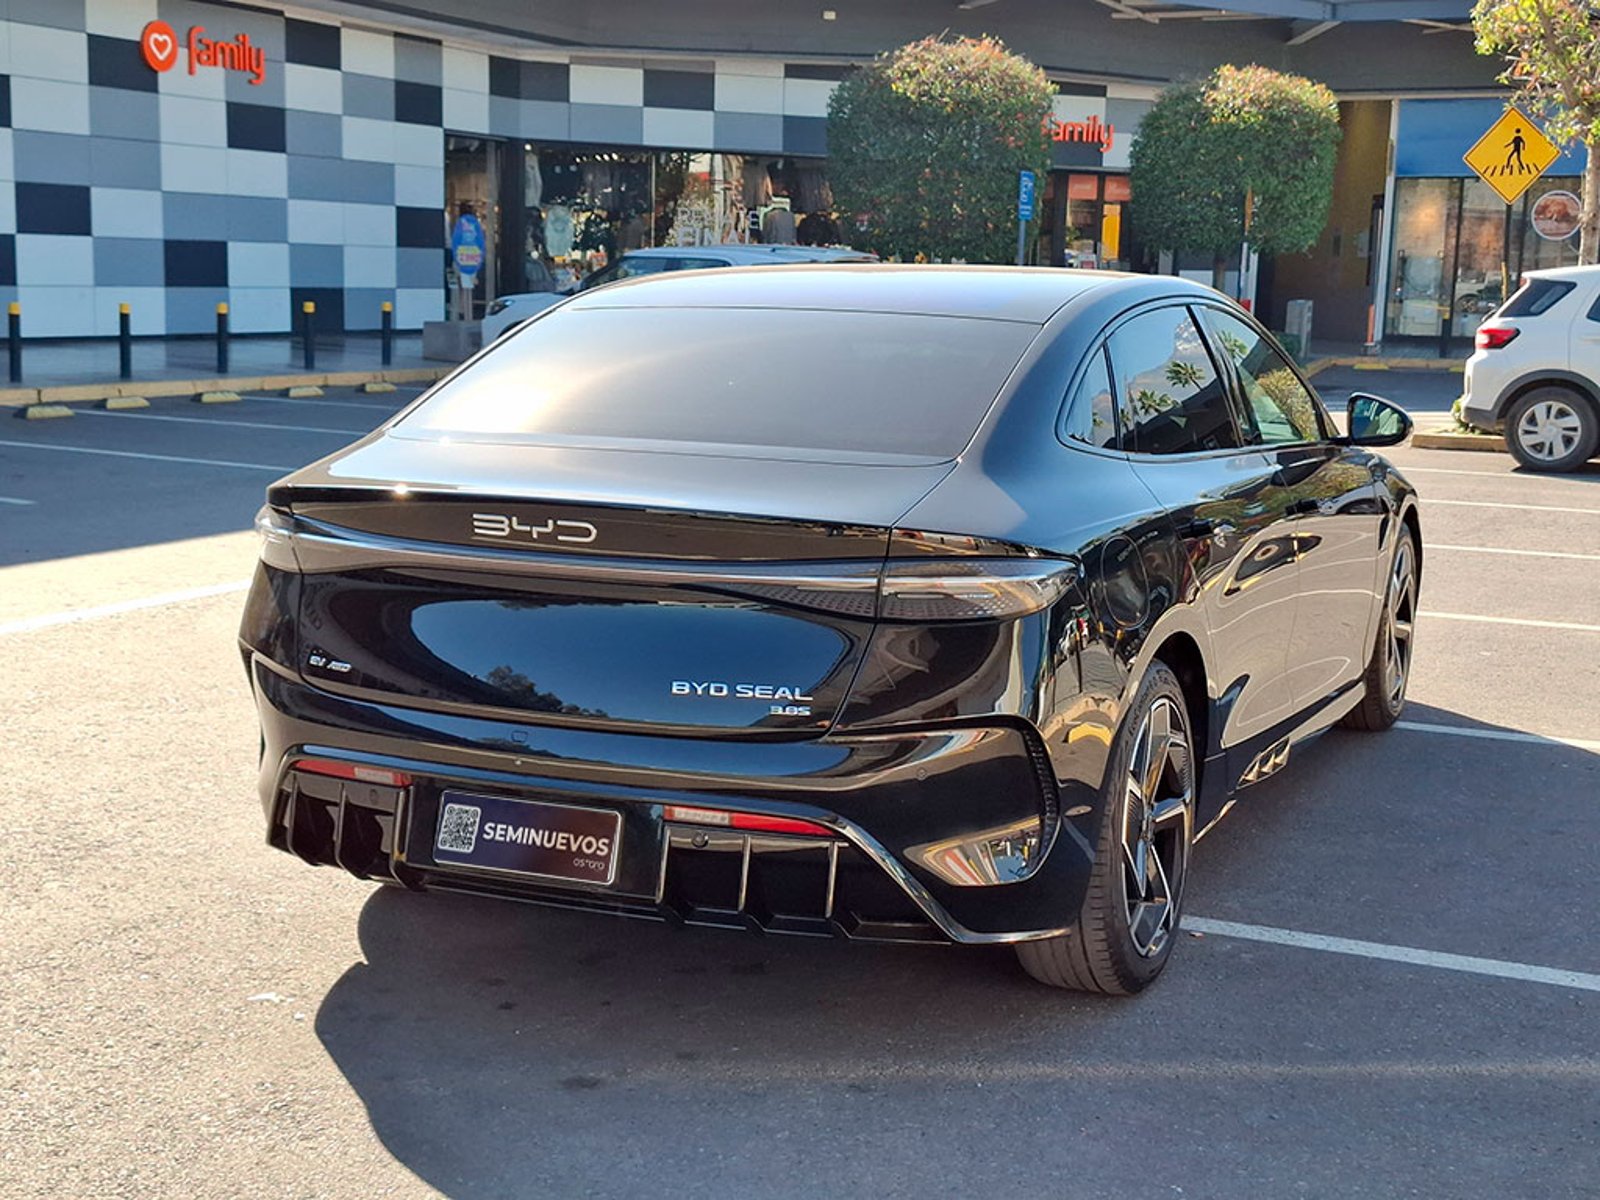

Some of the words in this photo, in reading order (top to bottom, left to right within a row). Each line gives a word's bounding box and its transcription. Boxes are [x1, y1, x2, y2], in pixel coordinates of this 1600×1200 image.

[187, 25, 266, 85] family
[472, 513, 598, 543] BYD
[671, 680, 729, 697] BYD
[735, 683, 814, 701] SEAL
[482, 822, 611, 856] SEMINUEVOS
